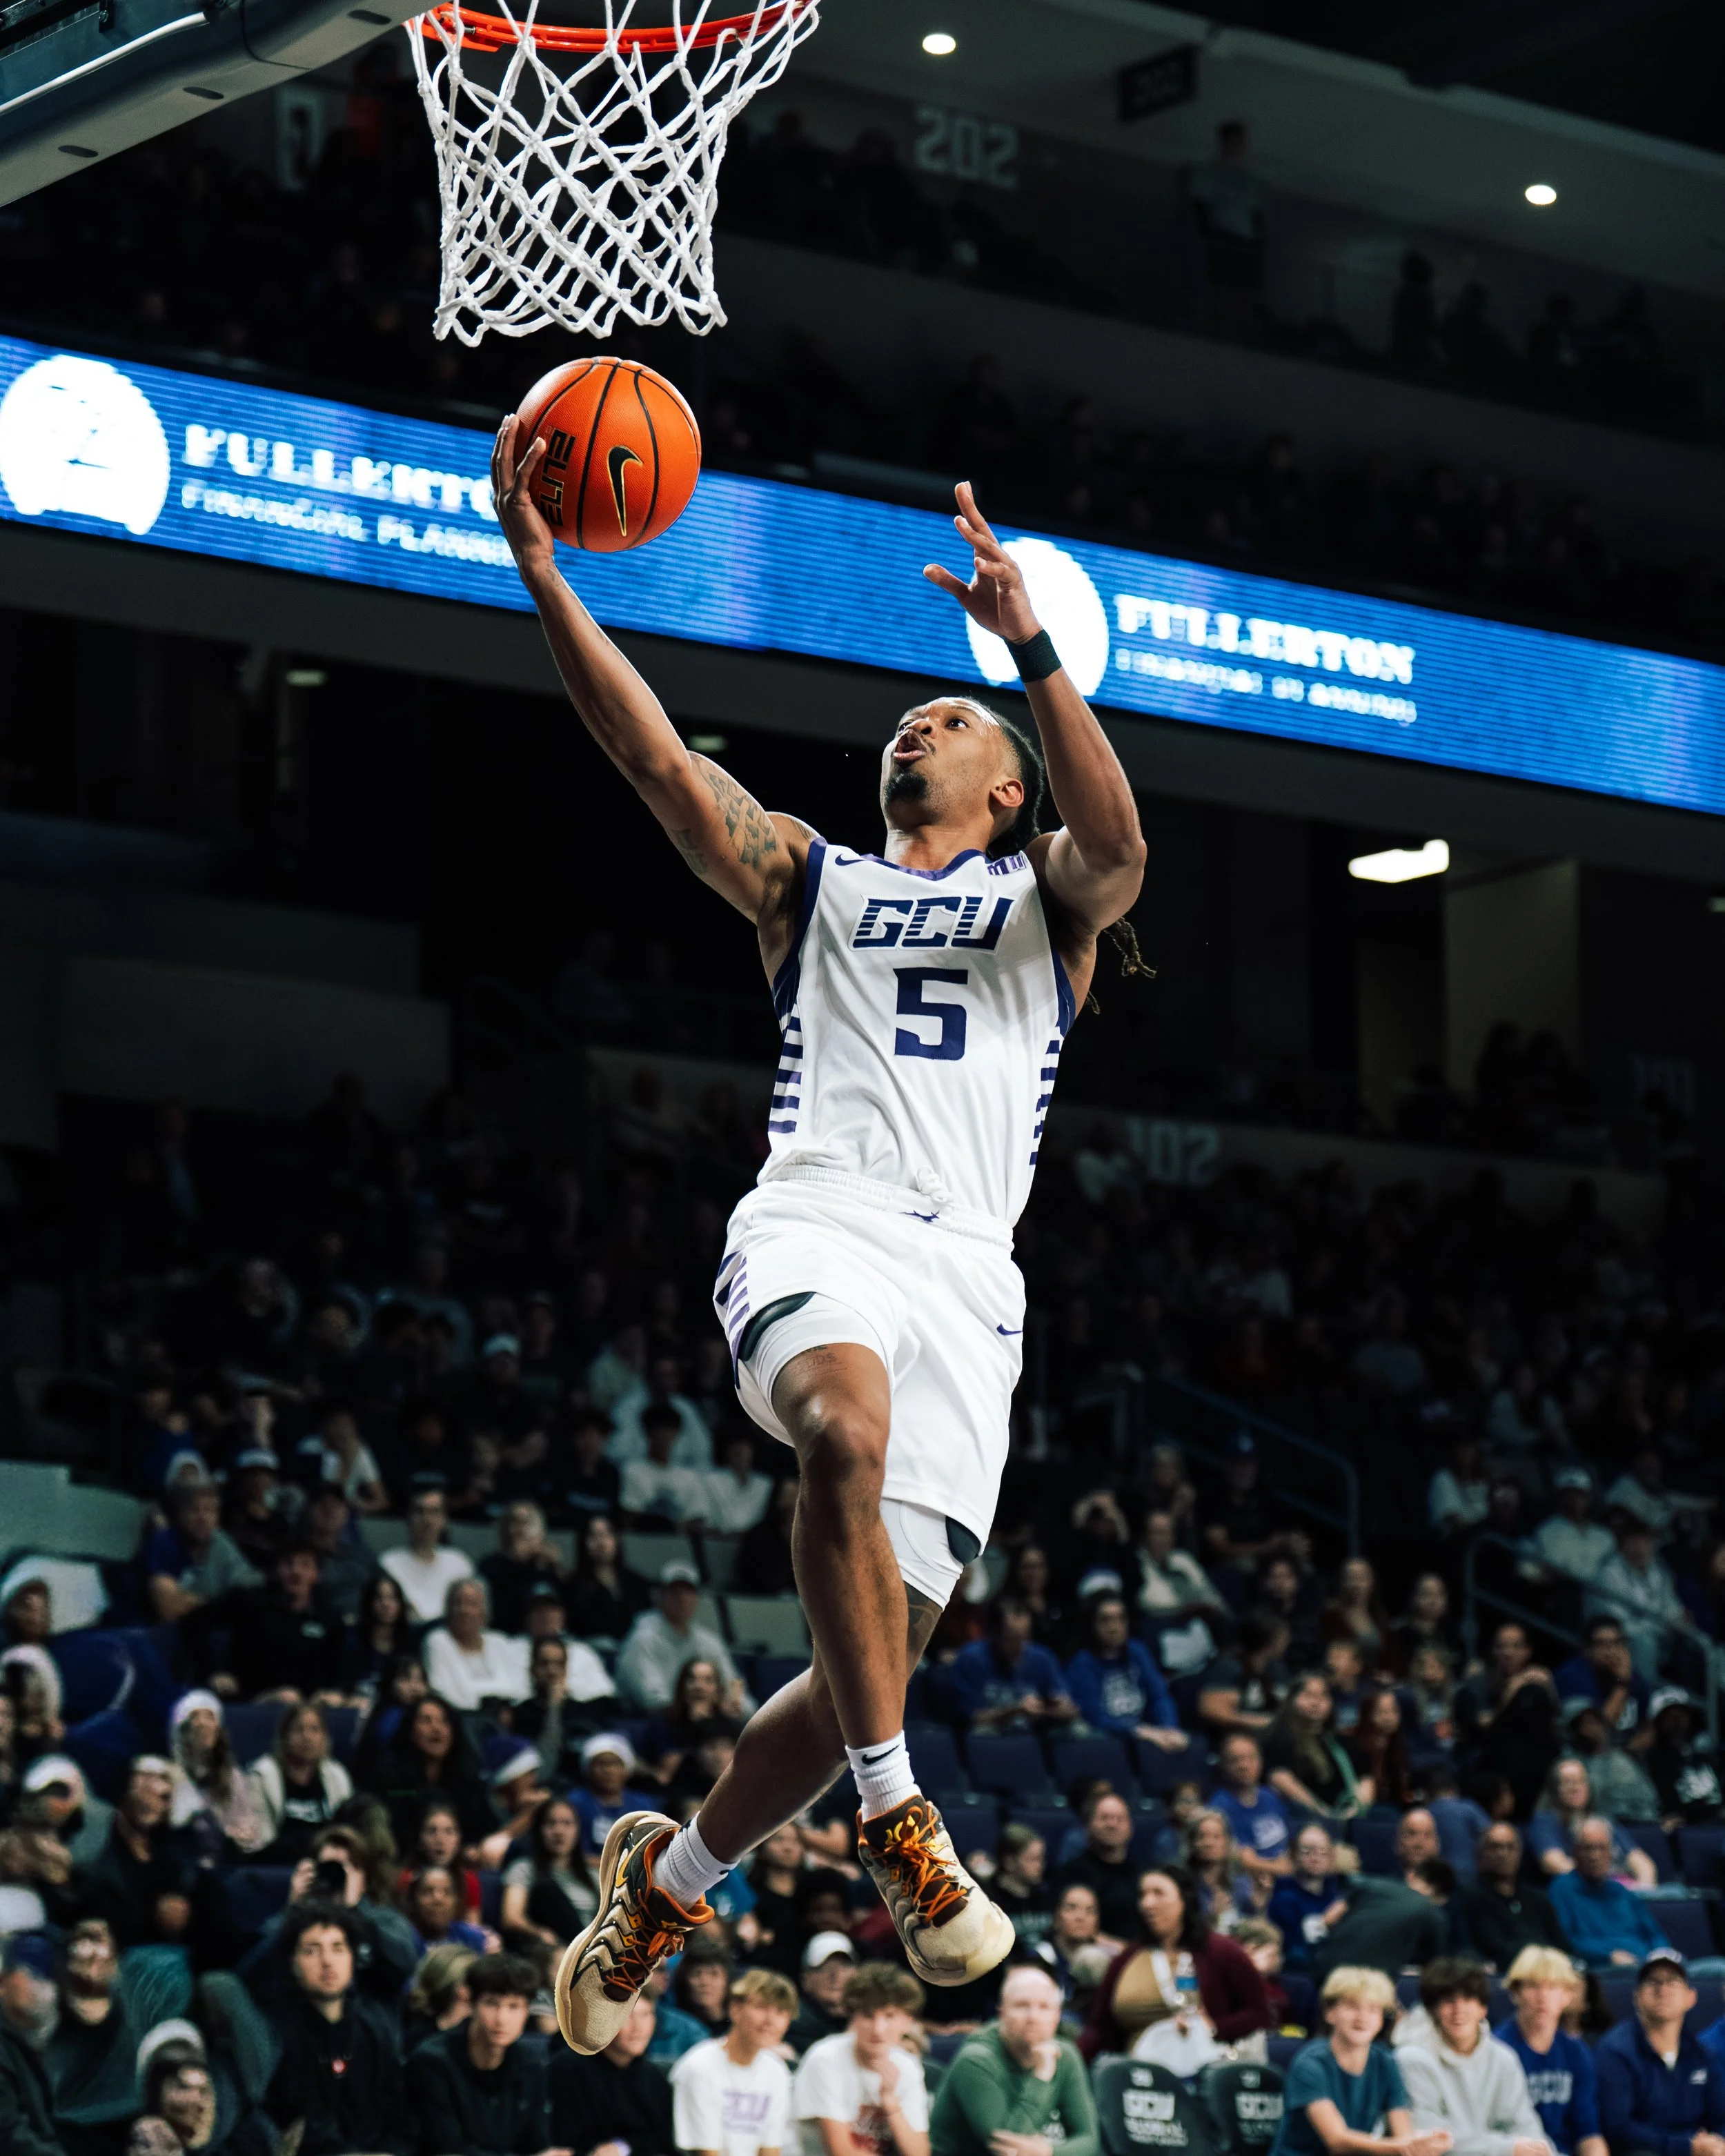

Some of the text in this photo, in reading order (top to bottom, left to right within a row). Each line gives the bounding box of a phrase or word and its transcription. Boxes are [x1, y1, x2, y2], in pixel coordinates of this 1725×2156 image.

[916, 108, 1018, 190] 202
[183, 424, 499, 522] FULLERTO
[540, 428, 576, 527] ELITE
[1114, 594, 1416, 685] FULLERTON
[850, 896, 1016, 952] GCU
[893, 967, 968, 1060] 5
